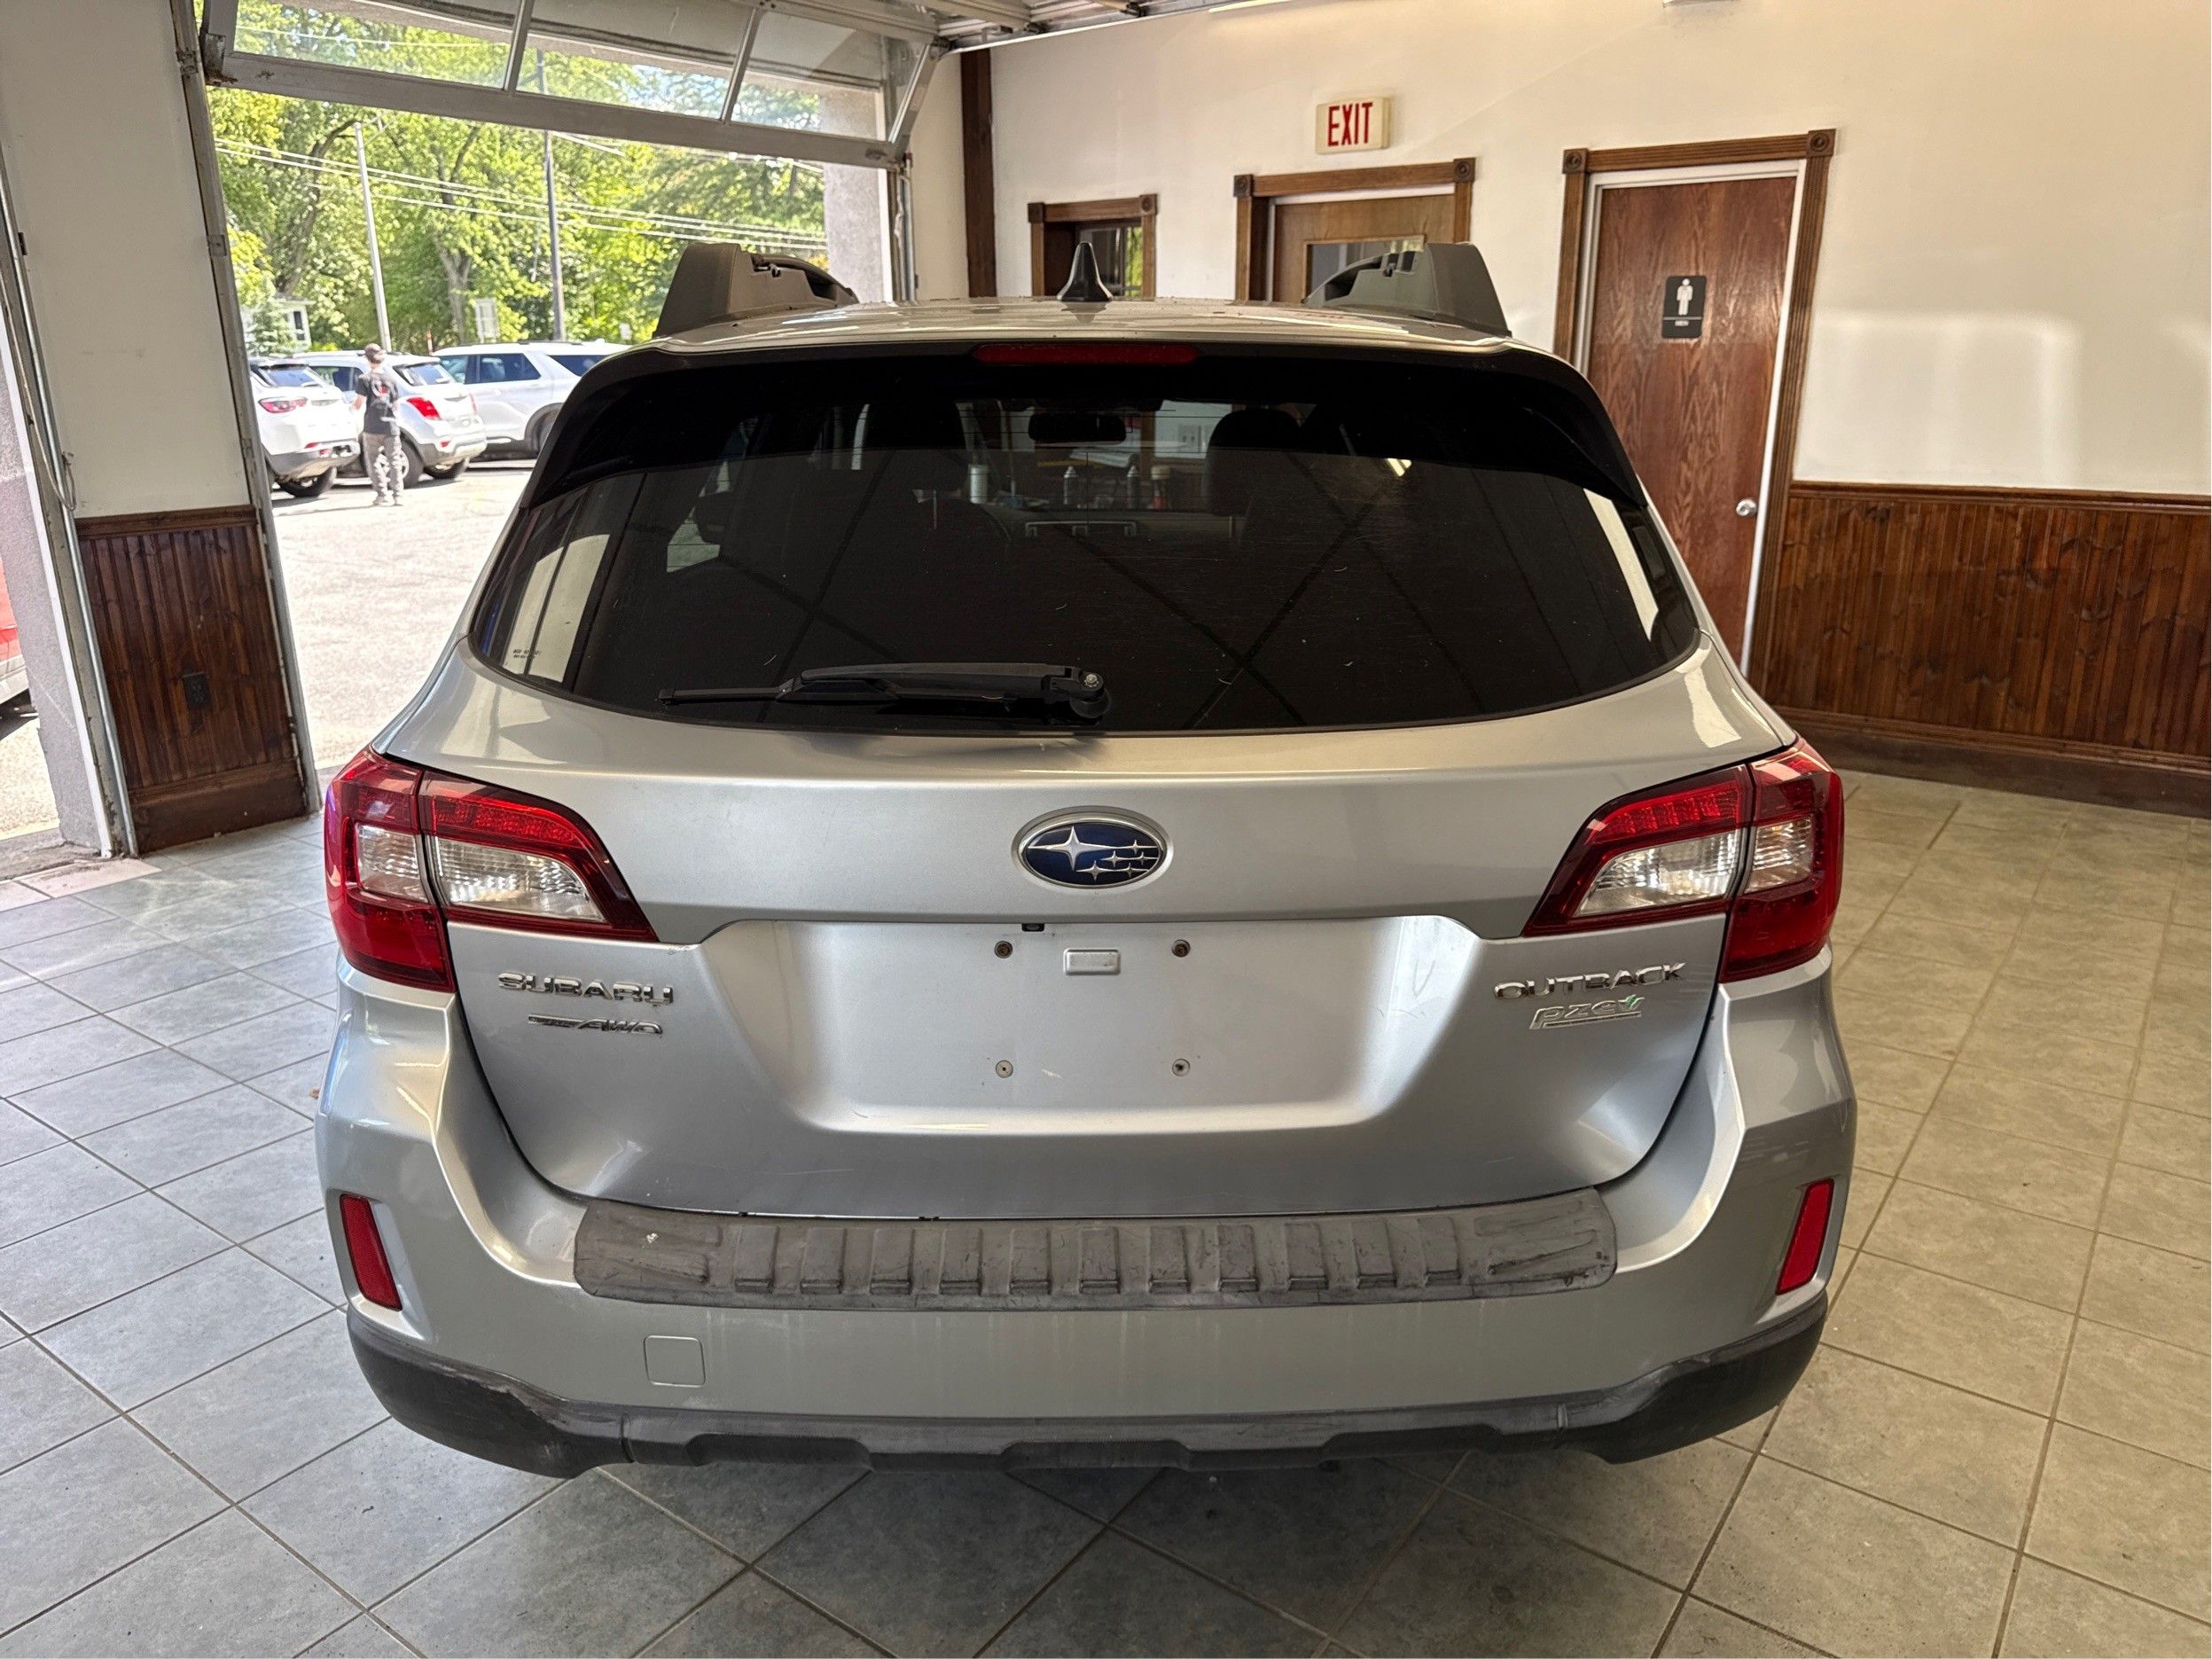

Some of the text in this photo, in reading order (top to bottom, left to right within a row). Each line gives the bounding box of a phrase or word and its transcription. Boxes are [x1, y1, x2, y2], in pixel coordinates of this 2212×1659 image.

[1327, 102, 1373, 147] EXIT
[497, 971, 674, 1006] SUBARU
[1494, 962, 1685, 999] OUTBACK
